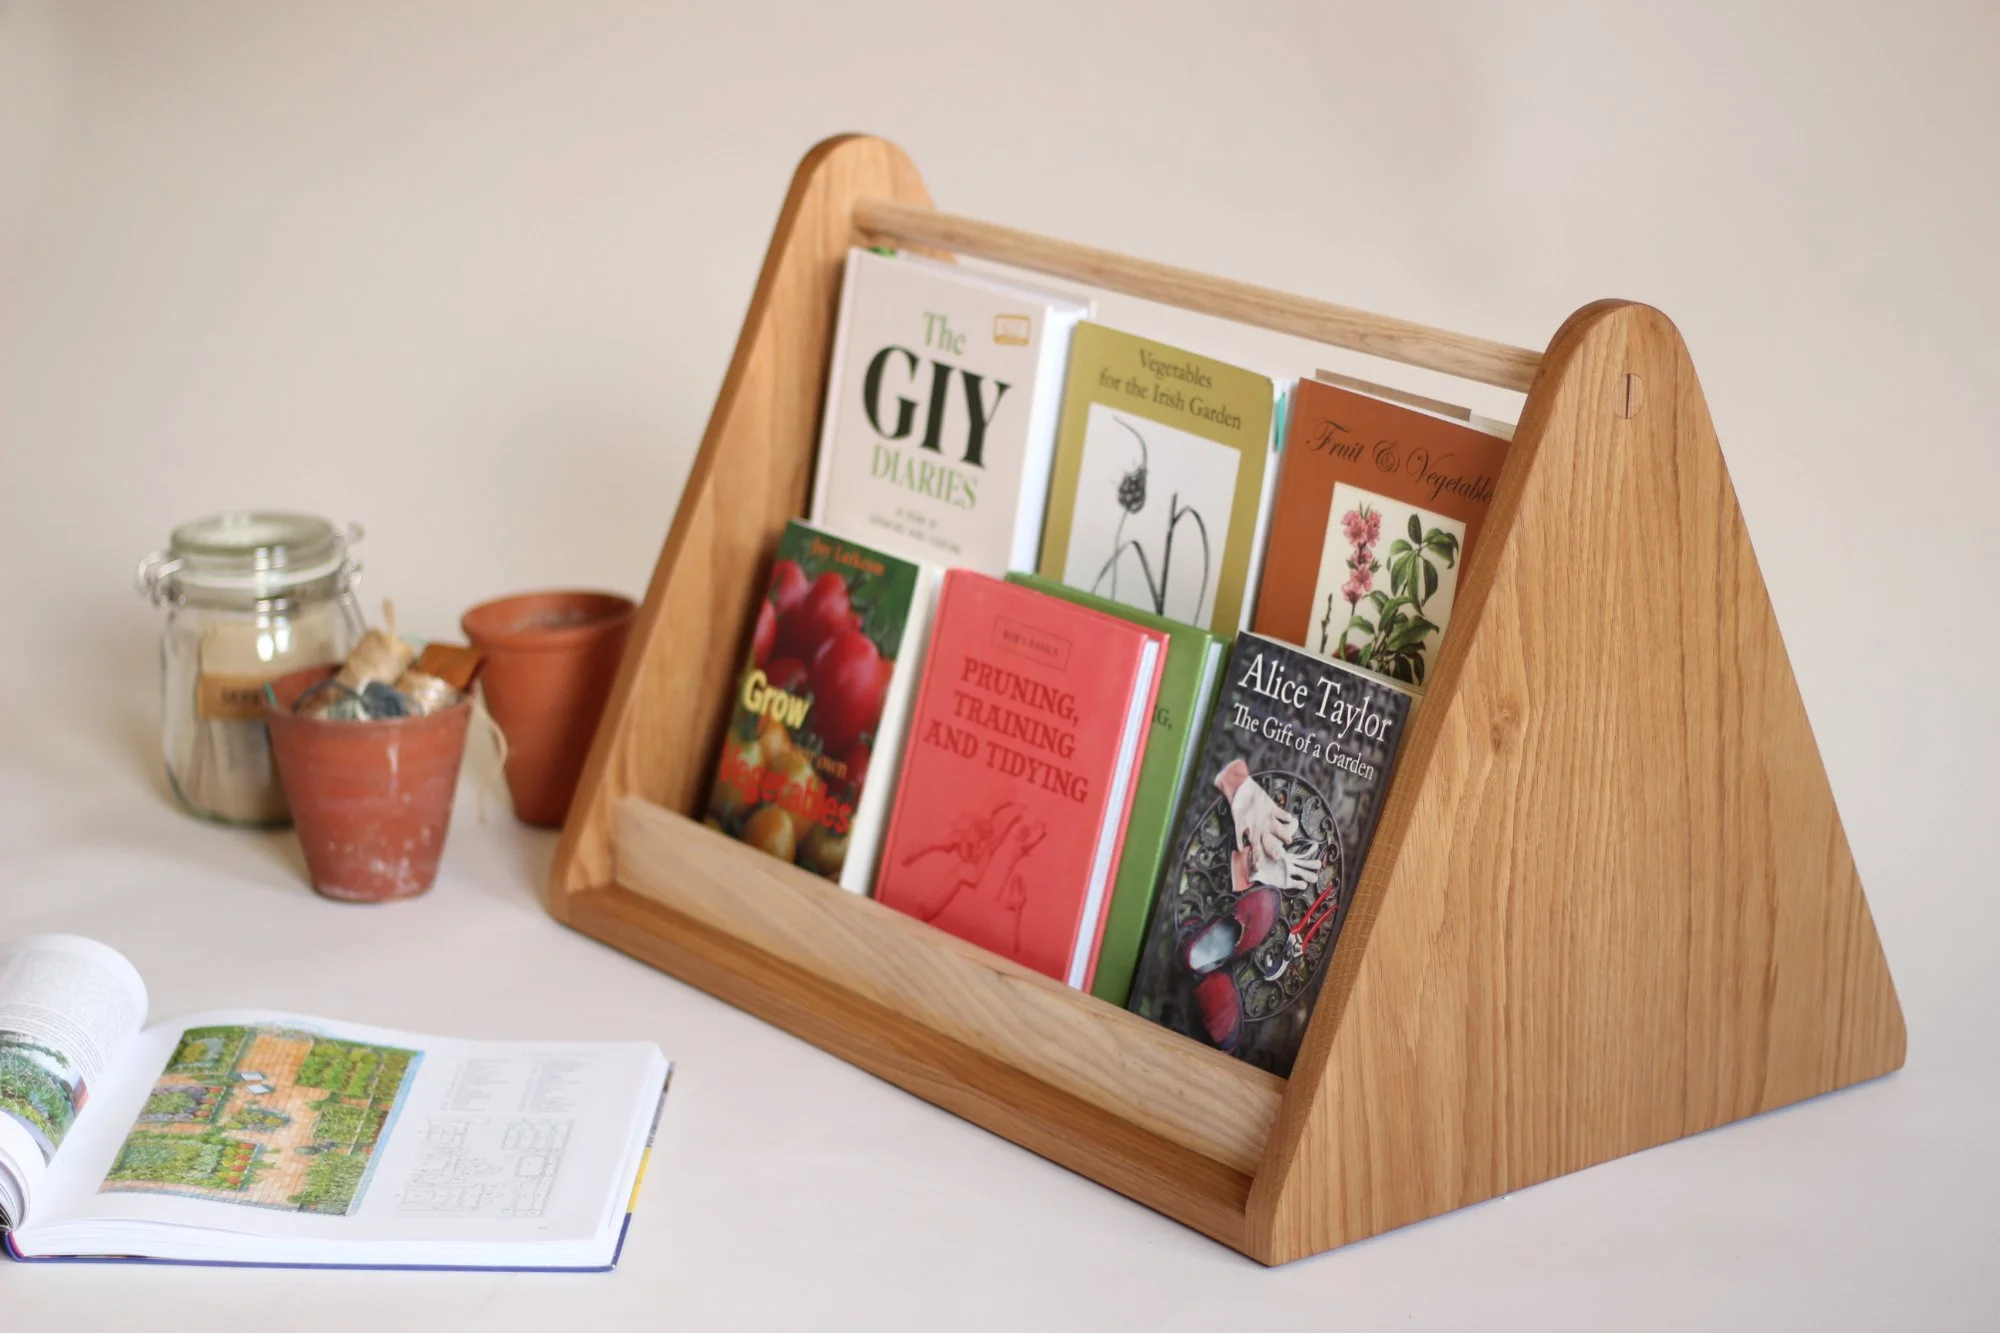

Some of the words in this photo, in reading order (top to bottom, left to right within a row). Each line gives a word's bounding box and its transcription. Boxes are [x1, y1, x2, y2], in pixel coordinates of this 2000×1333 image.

[923, 312, 966, 356] The
[1139, 347, 1212, 390] Vegetables
[863, 345, 1012, 469] GIY
[1099, 368, 1121, 391] for
[1125, 377, 1149, 399] the
[1152, 384, 1185, 412] Irish
[1189, 396, 1242, 430] Garden
[869, 444, 978, 511] DIARIES
[1306, 417, 1366, 463] Fruit
[1372, 439, 1400, 473] &
[1405, 447, 1494, 505] Vegetable
[743, 669, 810, 729] Grow
[954, 691, 1076, 760] TRAINING
[961, 657, 1079, 727] PRUNING,
[1238, 653, 1308, 709] Alice
[1315, 676, 1393, 742] Taylor
[924, 720, 979, 759] AND
[986, 741, 1089, 803] TIDYING
[1233, 703, 1259, 732] The
[1263, 716, 1294, 747] Gift
[1295, 733, 1315, 755] of
[1312, 744, 1320, 759] a
[1325, 741, 1375, 781] Garden
